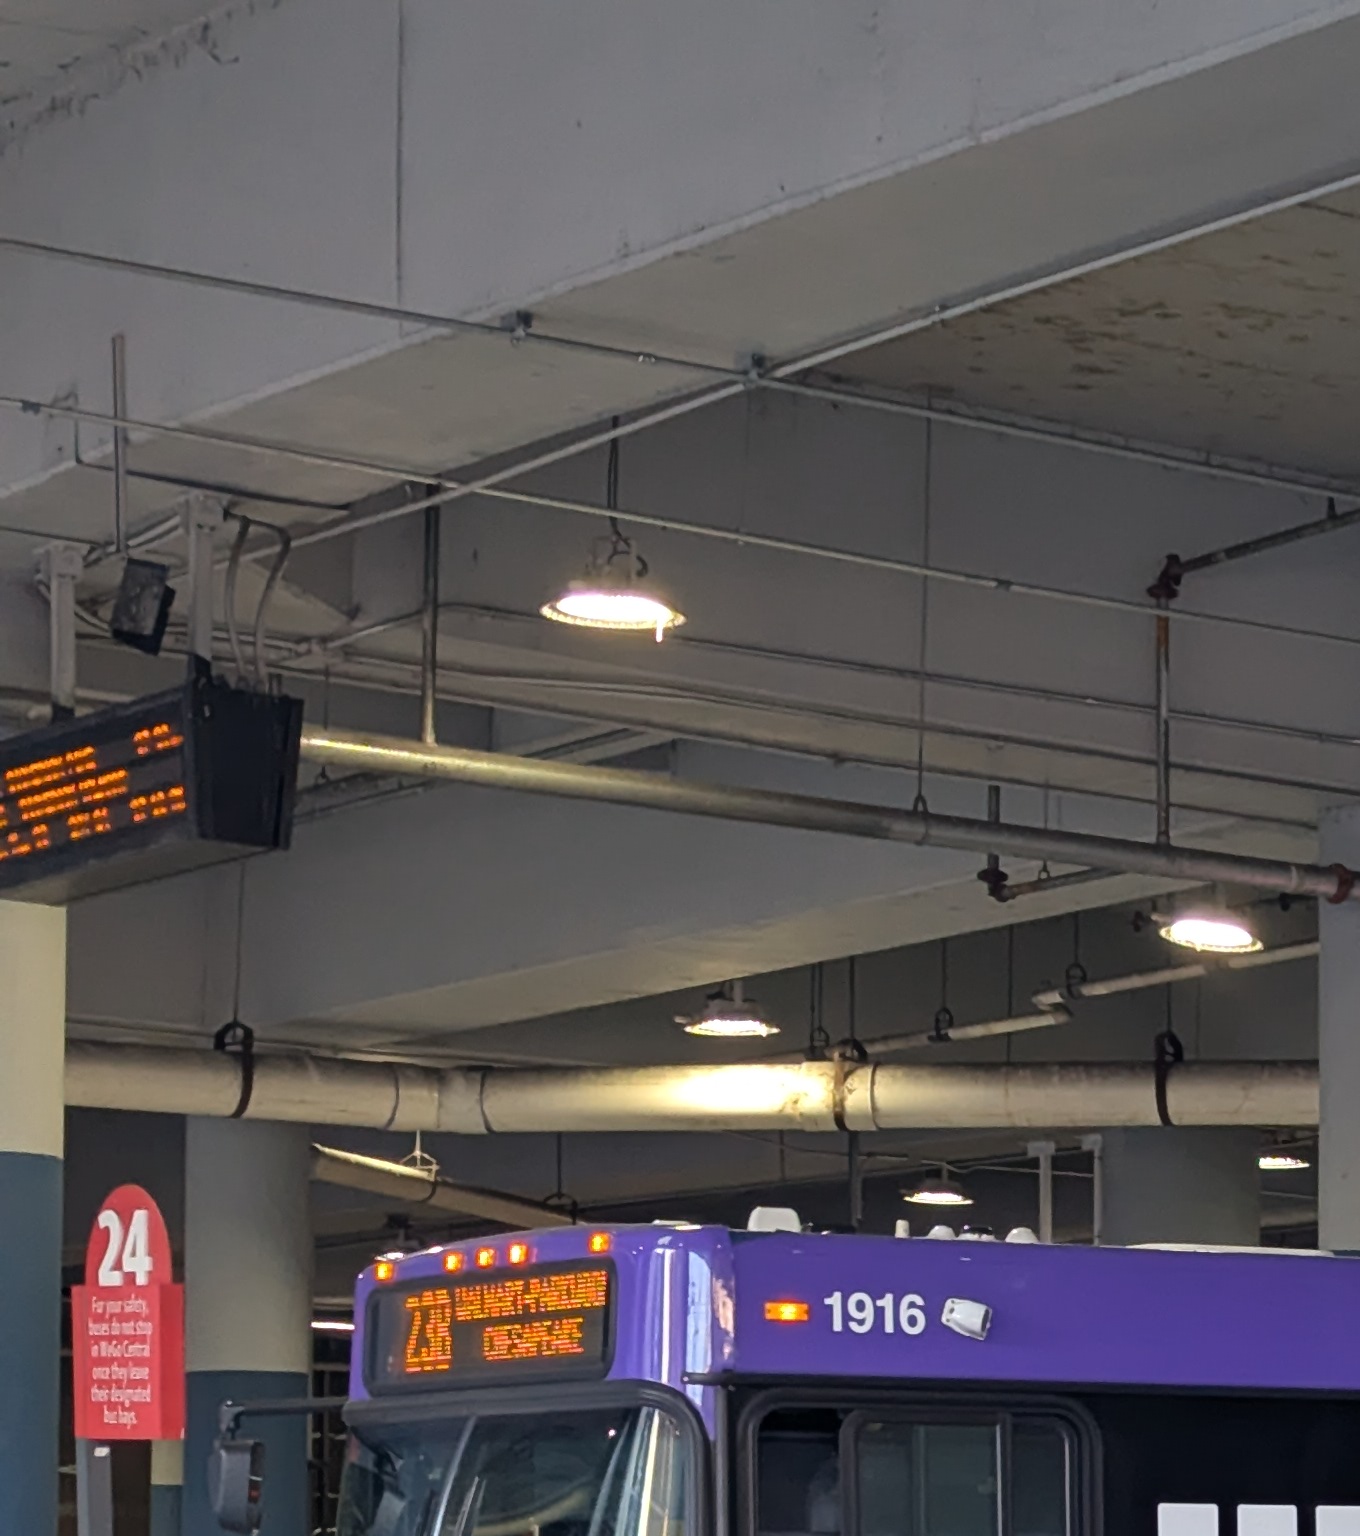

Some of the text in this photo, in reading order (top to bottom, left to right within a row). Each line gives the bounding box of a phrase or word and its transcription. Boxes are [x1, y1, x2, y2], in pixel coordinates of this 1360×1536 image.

[98, 1209, 153, 1287] 24
[92, 1296, 104, 1313] For
[106, 1301, 122, 1319] your
[823, 1291, 926, 1335] 1916
[121, 1320, 134, 1335] not
[136, 1320, 153, 1341] stop
[92, 1361, 149, 1388] once they leave
[111, 1383, 151, 1407] designated
